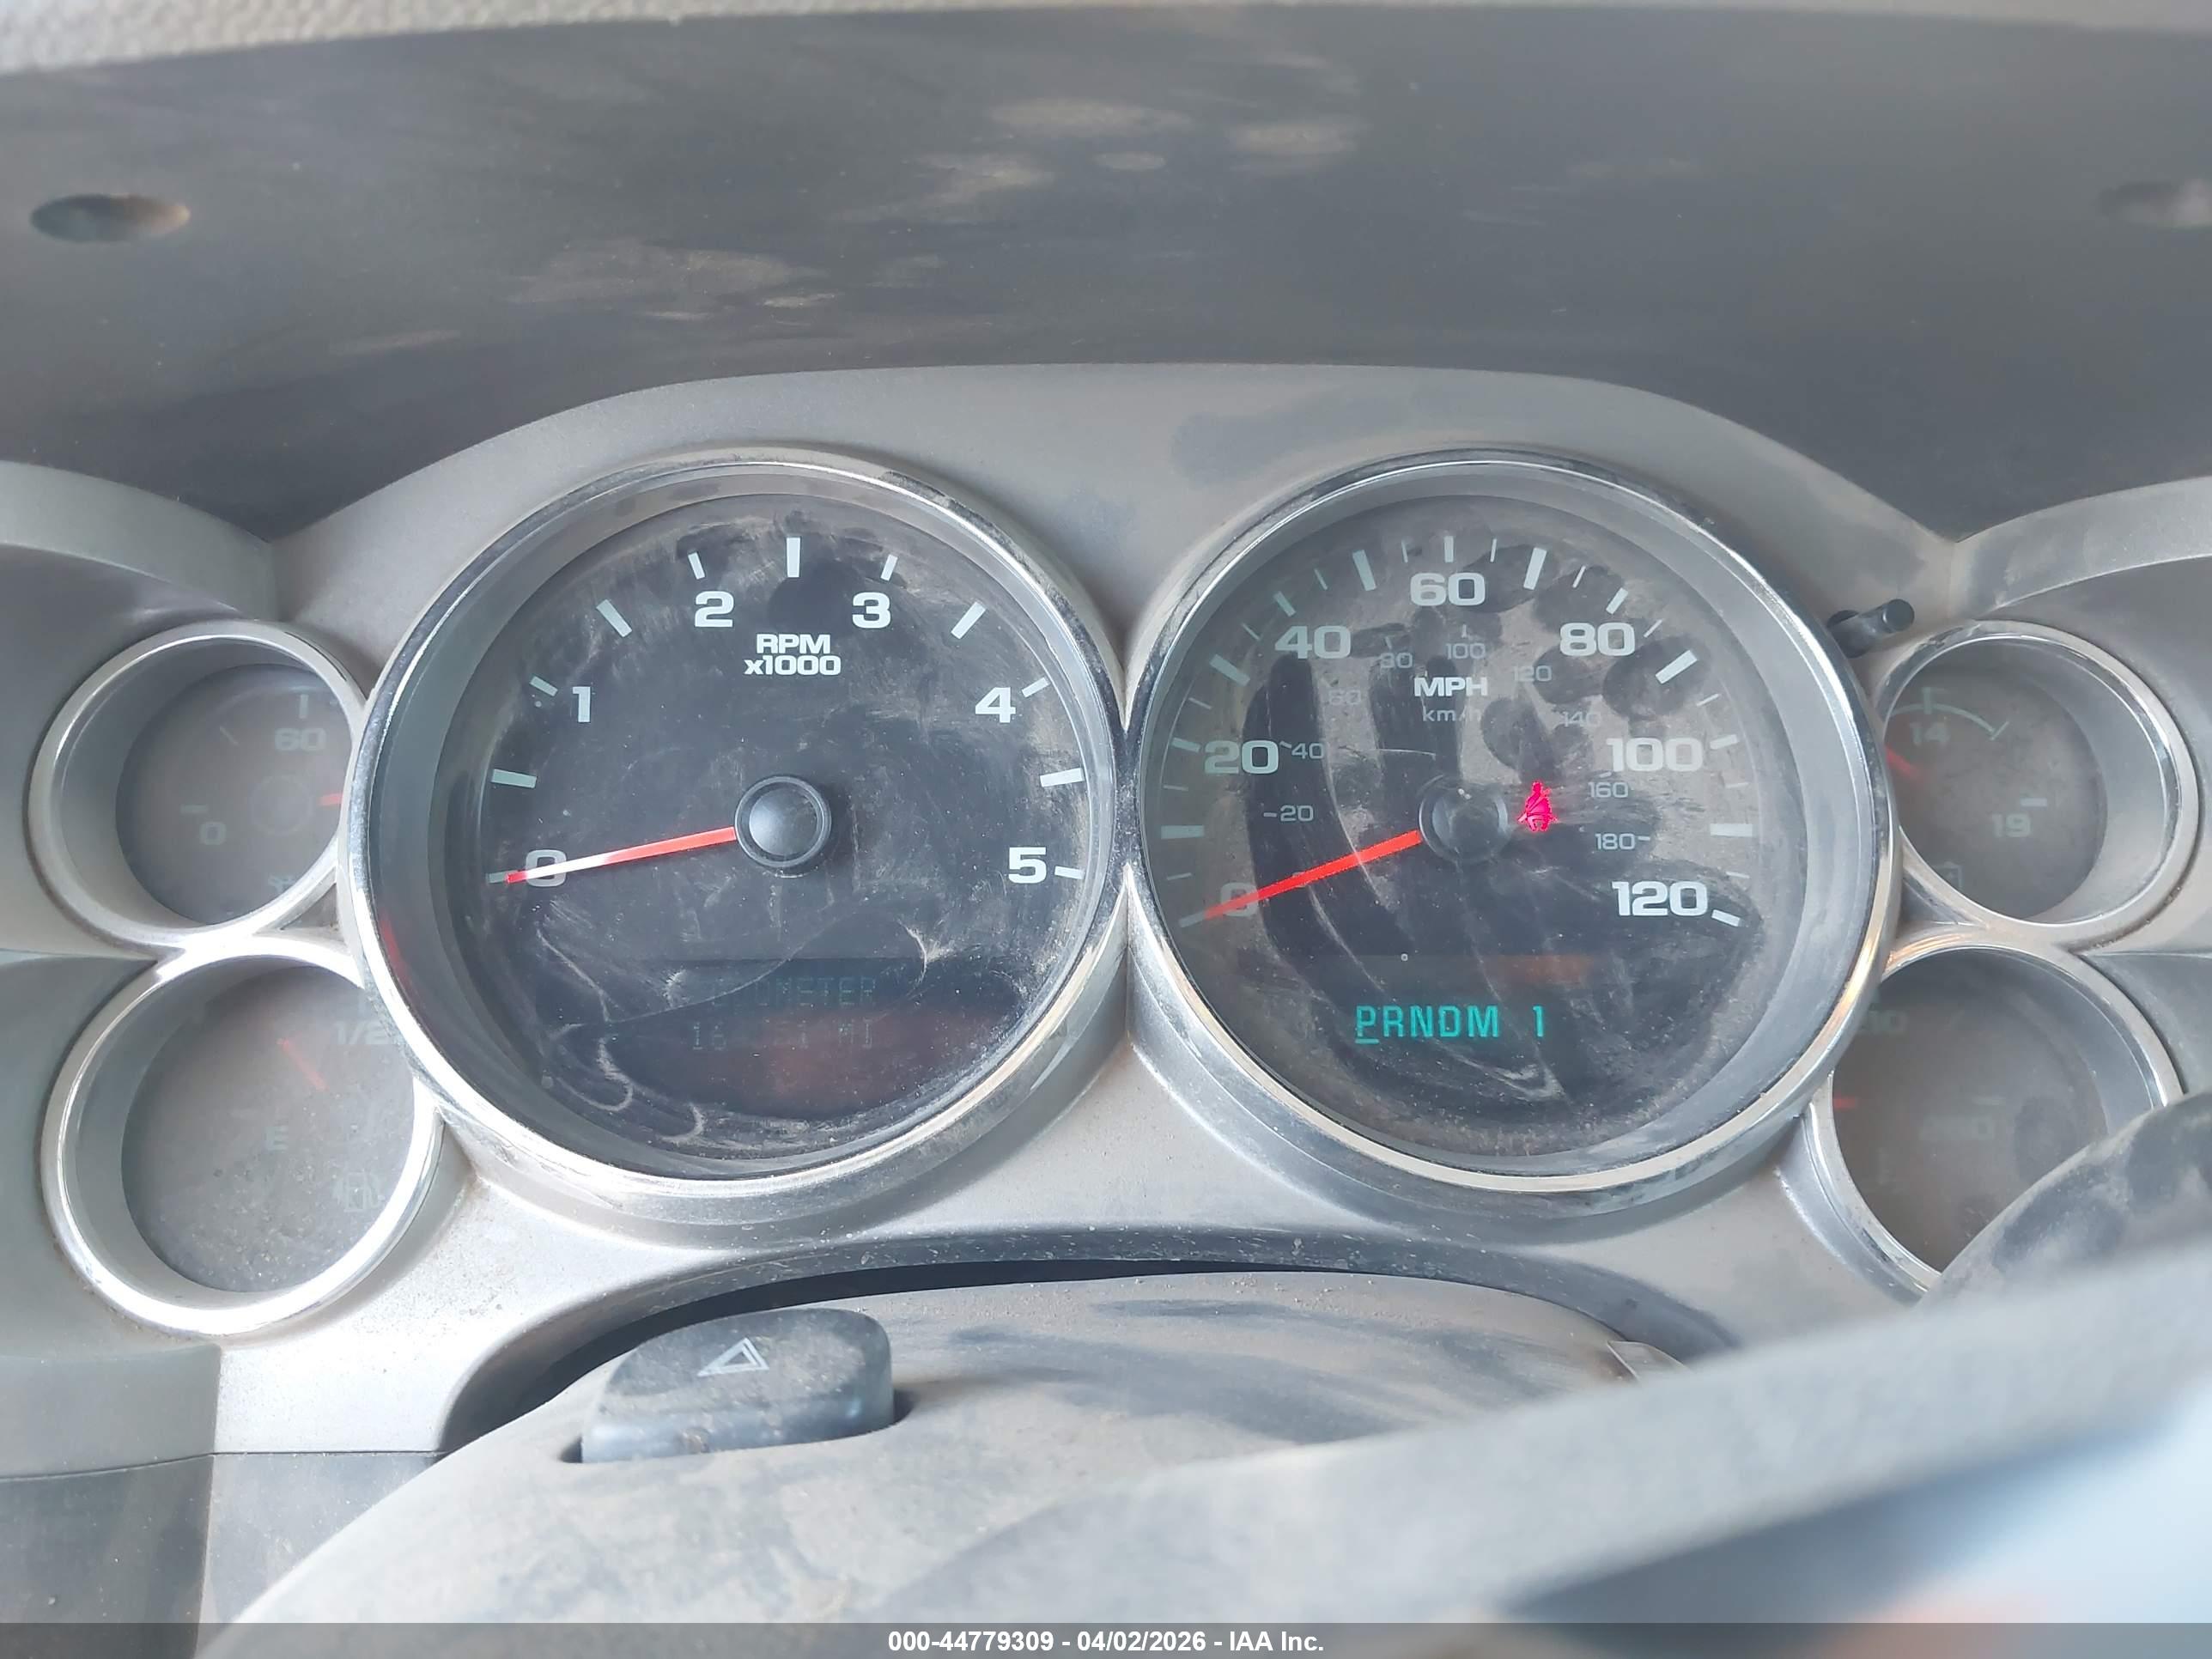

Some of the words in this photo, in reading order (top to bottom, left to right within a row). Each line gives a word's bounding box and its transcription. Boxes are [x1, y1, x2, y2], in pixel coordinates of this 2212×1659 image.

[1409, 572, 1486, 605] 60
[694, 591, 734, 628] 2
[852, 592, 891, 629] 3
[756, 634, 830, 653] RPM
[1273, 625, 1351, 659] 40
[1446, 643, 1486, 659] 100
[1559, 623, 1636, 656] 80
[744, 656, 841, 676] x1000
[1514, 665, 1553, 682] 120
[1413, 676, 1487, 697] MPH
[572, 686, 591, 722] 1
[975, 688, 1017, 723] 4
[1563, 710, 1601, 726] 140
[1909, 722, 1949, 745] 14
[1204, 739, 1279, 774] 20
[1291, 743, 1325, 760] 40
[1607, 738, 1704, 772] 100
[1588, 781, 1628, 799] 160
[1280, 805, 1315, 822] 20
[1992, 813, 2032, 838] 19
[198, 821, 227, 846] 0
[1595, 833, 1636, 850] 180
[525, 850, 567, 887] 0
[1008, 847, 1047, 883] 5
[1220, 882, 1257, 916] 0
[1611, 882, 1708, 916] 120
[1356, 1005, 1499, 1038] PRNDM
[1532, 1005, 1544, 1038] 1
